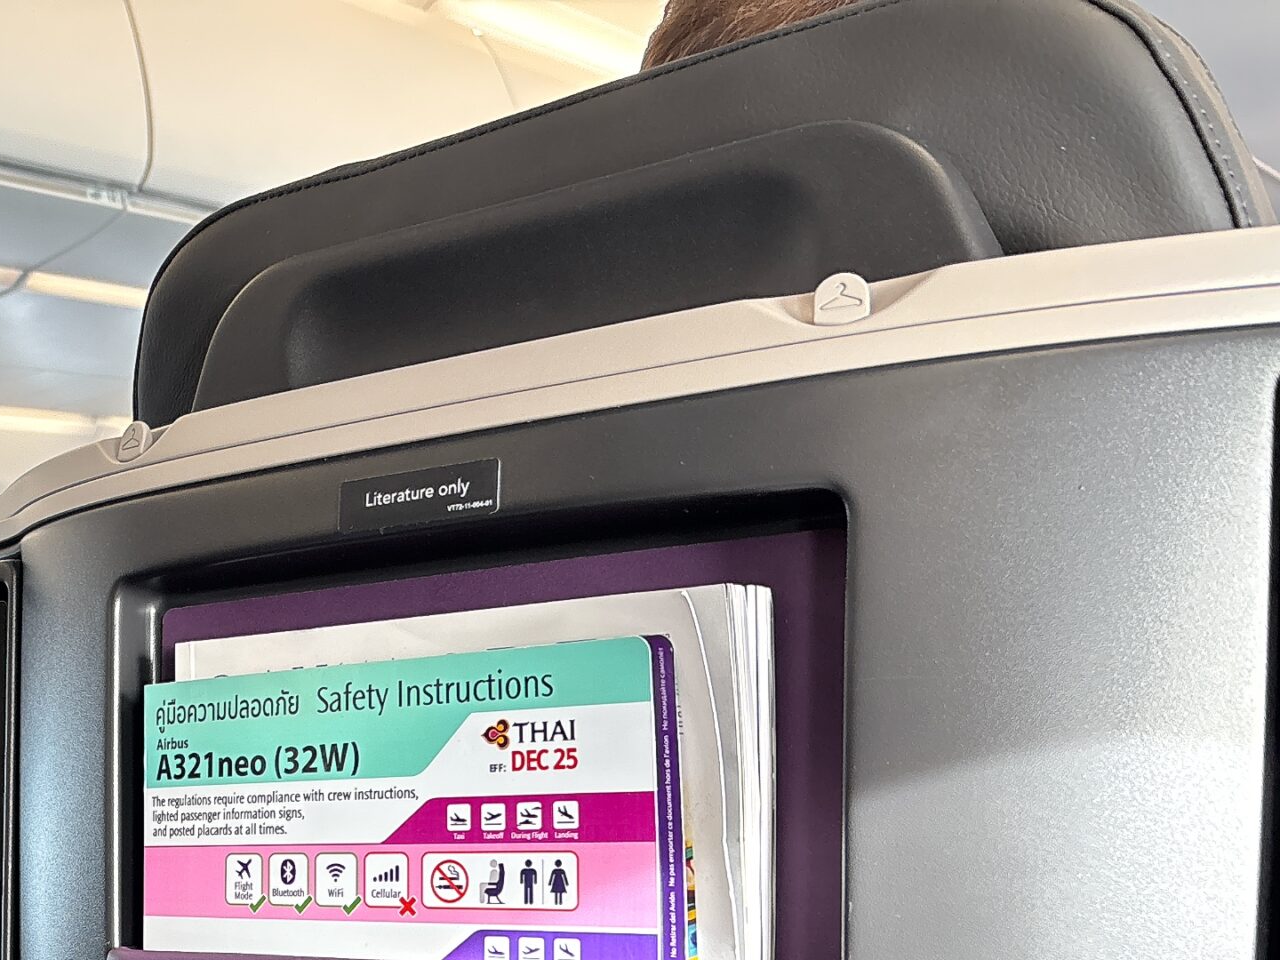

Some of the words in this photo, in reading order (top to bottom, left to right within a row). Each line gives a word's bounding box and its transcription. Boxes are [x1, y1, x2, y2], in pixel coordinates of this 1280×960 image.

[365, 486, 435, 508] Literature
[438, 476, 470, 498] only
[316, 681, 389, 716] Safety
[398, 668, 554, 708] Instructions
[156, 689, 300, 734] คู่มือความปลอดภัย
[512, 719, 577, 744] THAI
[156, 738, 189, 751] Airbus
[156, 751, 267, 781] A321neo
[274, 741, 360, 779] (32W)
[489, 763, 507, 773] EFF:
[511, 749, 549, 772] DEC
[553, 748, 578, 771] 25
[664, 759, 670, 768] de
[152, 795, 166, 807] The
[167, 793, 212, 808] regulations
[214, 791, 245, 807] require
[247, 789, 301, 805] compliance
[303, 788, 325, 802] with
[327, 790, 352, 801] crew
[354, 785, 419, 801] instructions,
[152, 809, 179, 824] lighted
[180, 810, 221, 823] passenger
[223, 806, 276, 820] information
[278, 806, 305, 821] signs,
[152, 824, 167, 837] and
[169, 824, 195, 839] posted
[197, 823, 232, 838] placards
[234, 824, 243, 835] at
[245, 822, 256, 835] all
[259, 821, 287, 835] times.
[667, 821, 673, 830] ce
[510, 831, 531, 840] During
[532, 831, 548, 840] Flight
[554, 831, 579, 840] Landing
[668, 831, 676, 863] emporter
[234, 881, 253, 892] Flight
[272, 888, 305, 897] Bluetooth
[328, 888, 344, 897] WiFi
[234, 891, 253, 900] Mode
[371, 888, 401, 899] Cellular
[670, 948, 677, 958] No
